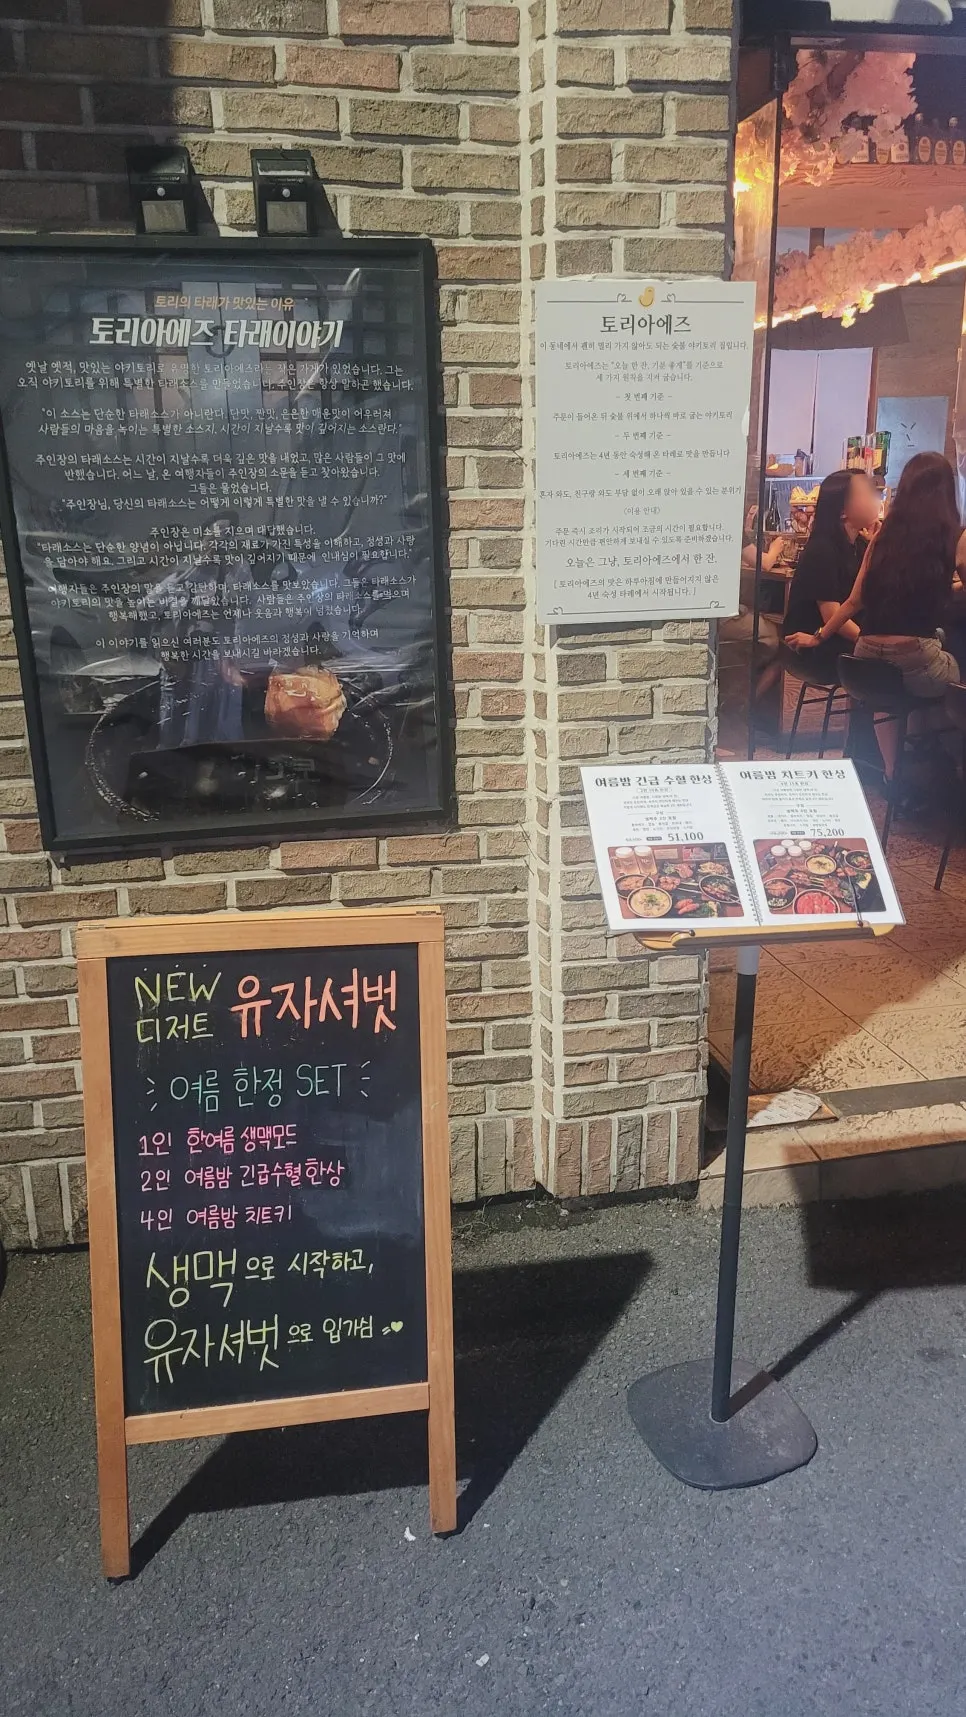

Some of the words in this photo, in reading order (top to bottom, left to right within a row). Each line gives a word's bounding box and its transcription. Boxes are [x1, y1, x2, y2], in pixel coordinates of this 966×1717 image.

[155, 296, 191, 308] 토리의
[233, 296, 268, 310] 맛있는
[271, 297, 294, 310] 이유
[600, 314, 691, 335] 토리아에즈
[89, 318, 214, 347] 토리아에즈
[224, 320, 343, 348] 타래이야기
[634, 393, 648, 401] 번째
[650, 392, 664, 401] 기준
[61, 409, 90, 420] 소스는
[94, 408, 125, 420] 단순한
[282, 408, 309, 420] 은은한
[312, 408, 350, 420] 매운맛이
[354, 408, 391, 420] 어우러져
[39, 424, 80, 435] 사람들의
[85, 424, 114, 435] 마음을
[118, 424, 148, 435] 녹이는
[152, 424, 183, 435] 특별한
[221, 424, 250, 435] 시간이
[255, 424, 292, 435] 지날수록
[296, 424, 314, 435] 맛이
[319, 424, 356, 435] 깊어지는
[623, 432, 630, 440] 두
[633, 432, 647, 440] 번째
[649, 432, 663, 440] 기준
[35, 454, 77, 465] 주인장의
[81, 454, 132, 465] 타래소스는
[136, 454, 165, 465] 시간이
[170, 454, 209, 465] 지날수록
[214, 454, 232, 465] 더욱
[236, 453, 255, 465] 깊은
[259, 453, 277, 465] 맛을
[314, 453, 333, 464] 많은
[335, 453, 373, 463] 사람들이
[376, 453, 384, 462] 그
[388, 453, 406, 463] 맛에
[554, 451, 596, 460] 토리아에즈는
[599, 451, 610, 460] 4년
[613, 451, 627, 459] 동안
[653, 450, 660, 459] 온
[686, 450, 700, 458] 맛을
[65, 469, 119, 480] 반했습니다.
[123, 469, 143, 480] 어느
[147, 469, 159, 480] 날,
[162, 469, 171, 480] 온
[175, 468, 225, 480] 여행자들이
[228, 468, 267, 479] 주인장의
[271, 467, 297, 478] 소문을
[300, 467, 318, 478] 듣고
[321, 467, 380, 479] 찾아왔습니다.
[633, 469, 647, 478] 번째
[649, 469, 663, 478] 기준
[189, 483, 217, 494] 그들은
[221, 482, 272, 493] 물었습니다.
[114, 499, 143, 510] 당신의
[148, 498, 196, 509] 타래소스는
[200, 497, 229, 509] 어떻게
[234, 496, 262, 508] 이렇게
[266, 496, 294, 507] 특별한
[298, 496, 315, 507] 맛을
[319, 495, 328, 507] 낼
[330, 496, 338, 506] 수
[150, 526, 189, 538] 주인장은
[194, 526, 220, 538] 미소를
[225, 525, 253, 536] 지으며
[257, 525, 315, 536] 대답했습니다.
[95, 542, 125, 553] 단순한
[130, 541, 160, 553] 양념이
[209, 540, 238, 550] 각각의
[241, 539, 268, 550] 재료가
[272, 538, 290, 549] 가진
[294, 538, 321, 549] 특성을
[367, 536, 394, 546] 정성과
[397, 535, 415, 546] 사랑
[566, 557, 595, 568] 오늘은
[599, 556, 620, 567] 그냥,
[623, 554, 690, 566] 토리아에즈에서
[693, 553, 703, 564] 한
[559, 577, 605, 588] 토리아에즈의
[607, 577, 623, 587] 맛은
[625, 575, 662, 586] 하루아침에
[588, 590, 599, 600] 4년
[602, 589, 617, 598] 숙성
[96, 639, 104, 648] 이
[109, 638, 148, 649] 이야기를
[152, 637, 179, 648] 읽으신
[184, 636, 220, 646] 여러분도
[223, 634, 279, 645] 토리아에즈의
[282, 633, 309, 644] 정성과
[312, 631, 339, 642] 사랑을
[342, 629, 379, 640] 기억하며
[161, 651, 189, 661] 행복한
[193, 649, 220, 660] 시간을
[223, 648, 260, 659] 보내시길
[264, 645, 321, 657] 바라겠습니다.
[596, 777, 631, 787] 여름밤
[635, 776, 659, 786] 긴급
[664, 775, 687, 785] 수혈
[690, 775, 712, 784] 한상
[740, 771, 776, 780] 여름밤
[782, 770, 818, 779] 치트키
[823, 769, 845, 779] 한상
[668, 832, 703, 841] 51,100
[810, 828, 844, 837] 75,200
[134, 972, 221, 1008] NEW
[228, 968, 397, 1038] 유자셔벗
[136, 1012, 214, 1043] 디저트
[170, 1070, 220, 1112] 여름
[233, 1061, 283, 1108] 한정
[296, 1063, 347, 1097] SET
[139, 1132, 173, 1156] 1인
[187, 1126, 235, 1155] 한여름
[240, 1123, 297, 1152] 생맥모드
[141, 1169, 171, 1192] 2인
[184, 1165, 233, 1189] 여름밤
[140, 1208, 173, 1231] 4인
[187, 1205, 238, 1229] 여름밤
[245, 1204, 292, 1224] 치트키
[288, 1248, 374, 1279] 시작하고,
[322, 1315, 373, 1344] 입가심
